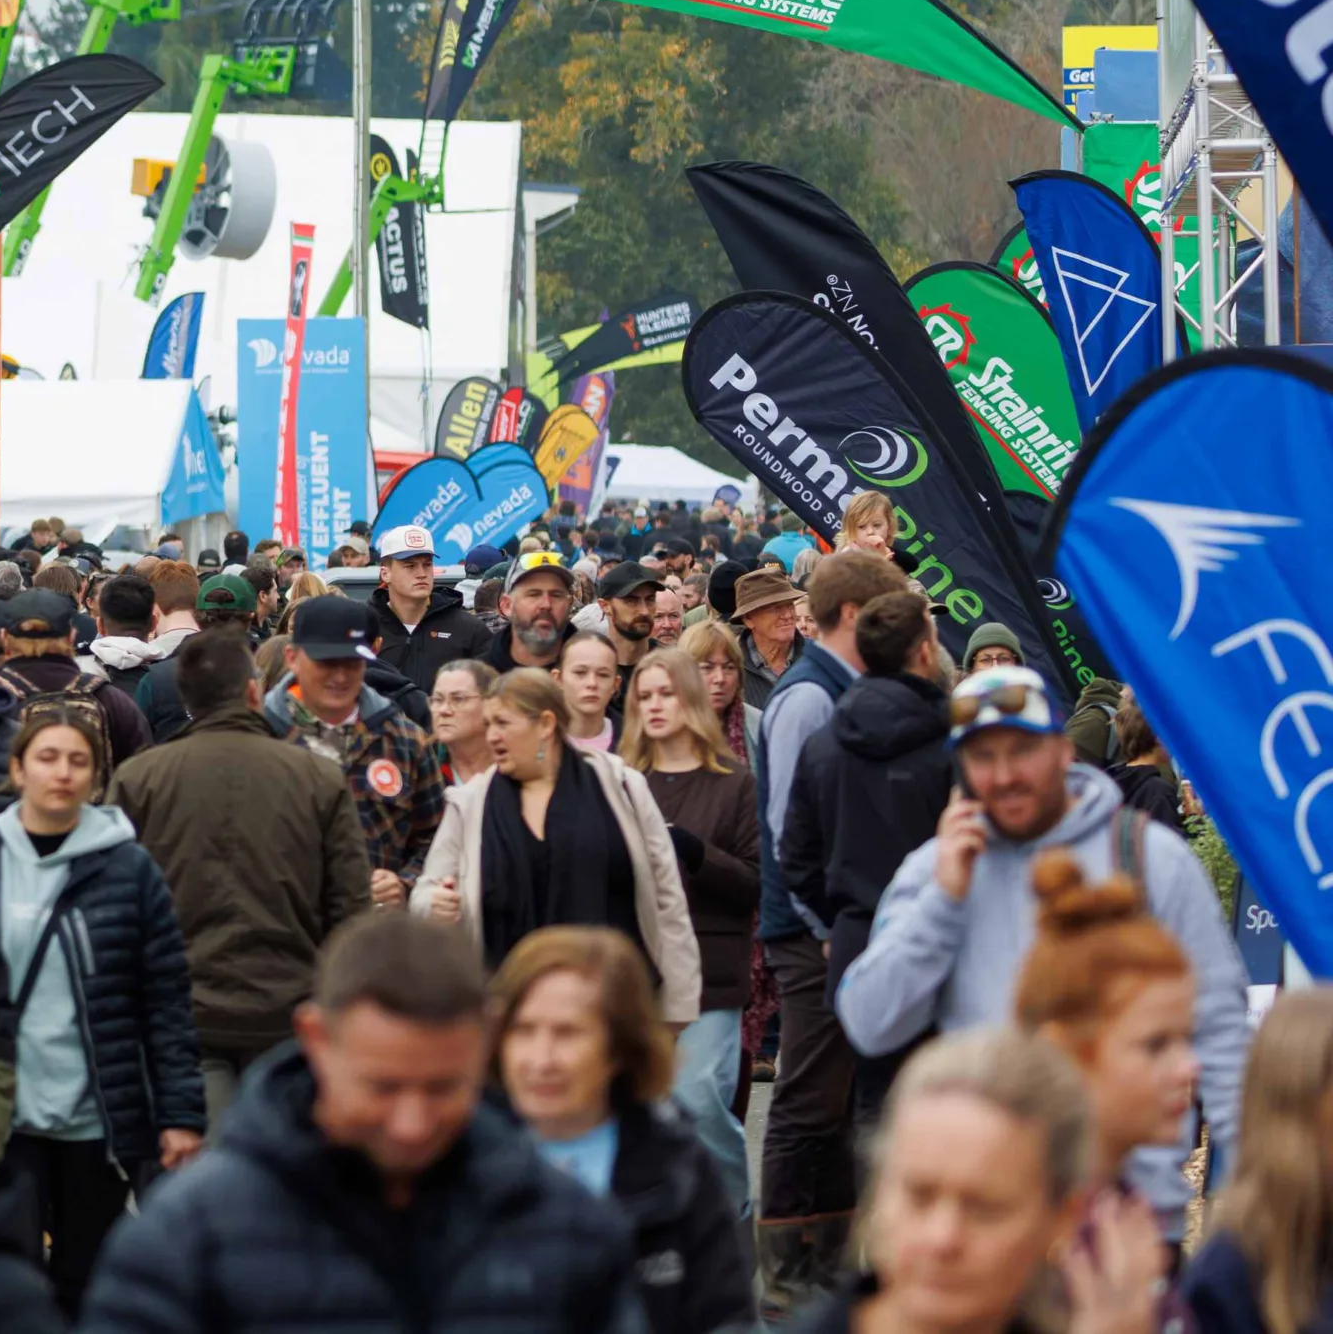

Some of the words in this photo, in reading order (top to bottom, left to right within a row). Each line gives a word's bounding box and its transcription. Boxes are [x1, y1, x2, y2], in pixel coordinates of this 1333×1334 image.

[385, 206, 408, 294] ACTUS
[637, 301, 690, 324] HUNTERS
[444, 382, 488, 459] Allen
[954, 380, 1015, 439] FENCING
[1011, 439, 1062, 495] SYSTEM
[968, 357, 1082, 483] Strainrit
[310, 431, 329, 548] EFFLUENT
[412, 479, 461, 528] evada
[473, 484, 532, 536] nevada
[732, 423, 823, 514] ROUNDWOOD
